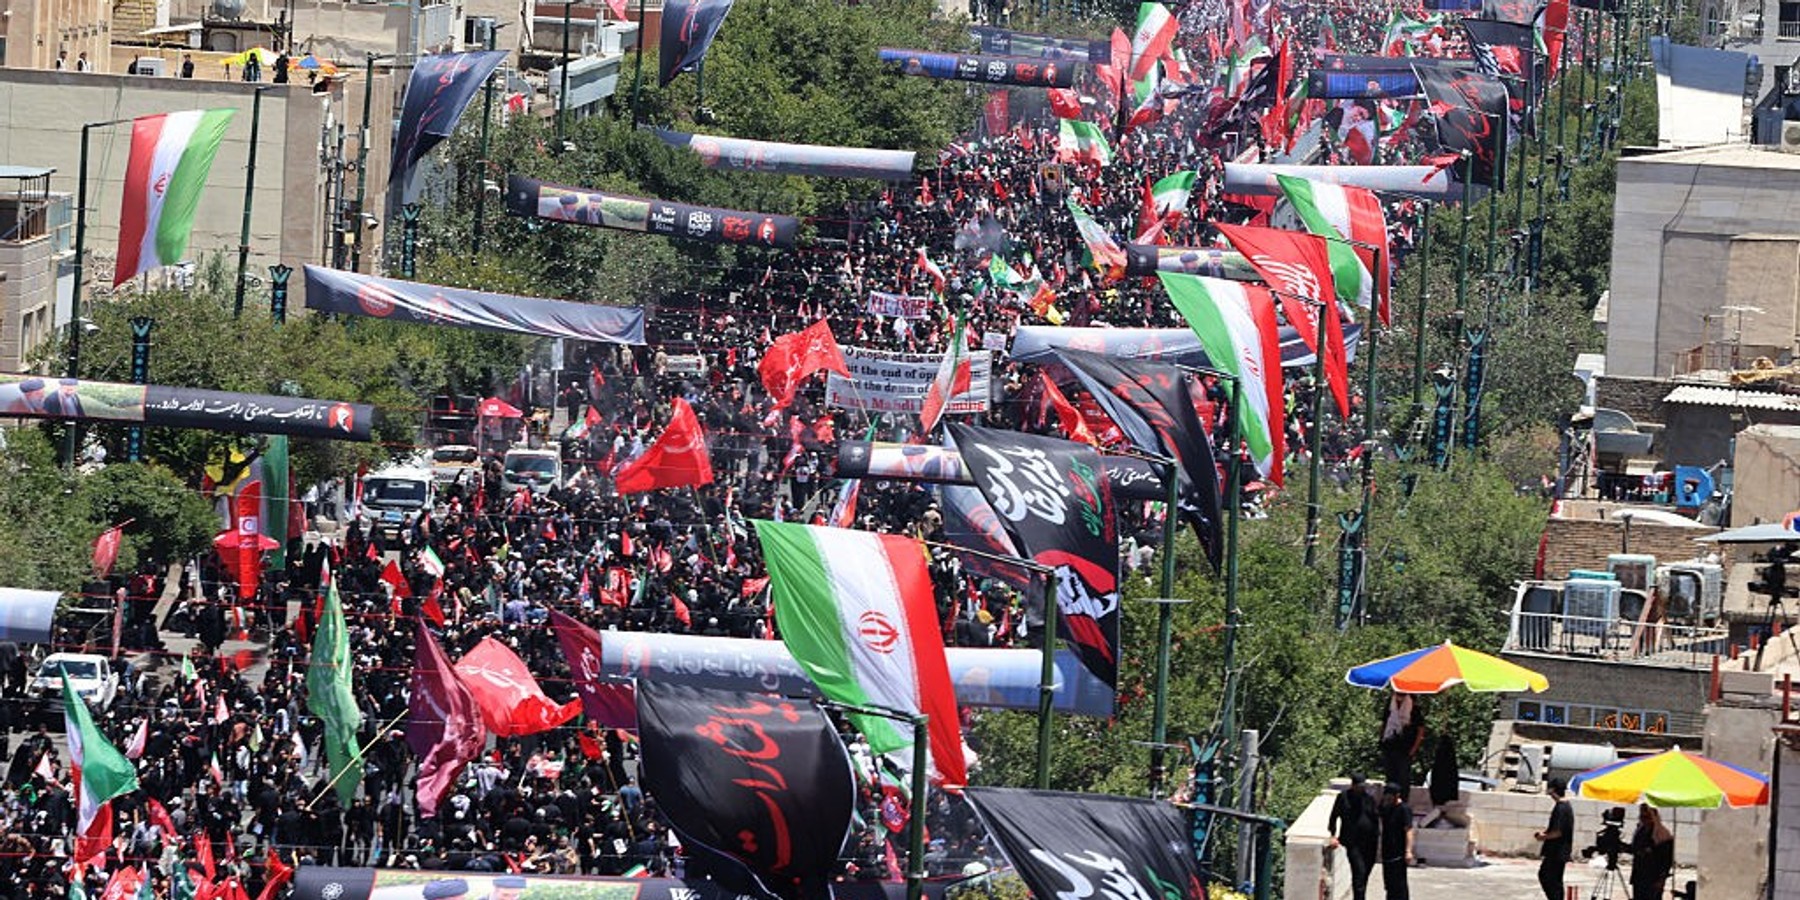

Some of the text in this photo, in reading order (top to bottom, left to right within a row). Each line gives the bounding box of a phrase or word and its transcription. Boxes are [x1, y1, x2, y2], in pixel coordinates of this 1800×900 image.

[650, 212, 675, 225] Must
[856, 350, 889, 363] people
[861, 364, 878, 376] the
[880, 367, 902, 378] end
[904, 369, 918, 379] of
[864, 380, 882, 392] the
[917, 385, 929, 394] of
[871, 397, 915, 411] Mahdi
[271, 404, 315, 424] انقلاب
